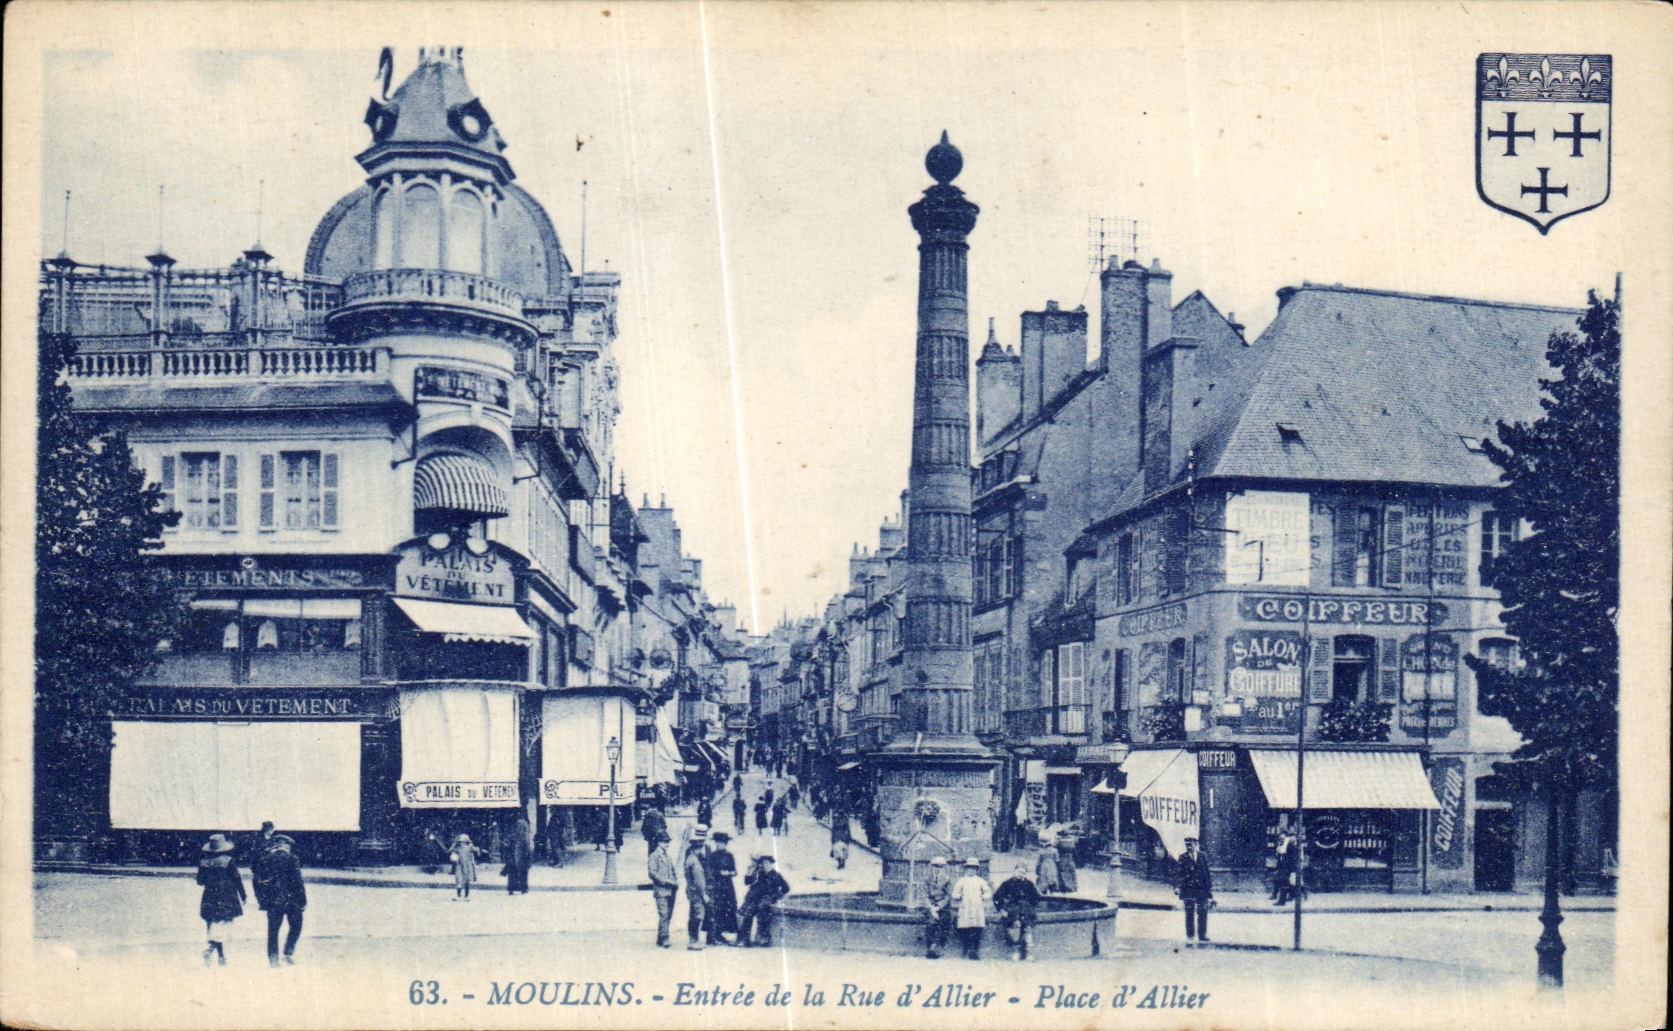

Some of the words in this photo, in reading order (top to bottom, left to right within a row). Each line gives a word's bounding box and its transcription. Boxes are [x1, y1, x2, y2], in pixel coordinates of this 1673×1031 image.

[420, 547, 495, 574] PALAIS
[447, 570, 467, 581] DU
[1256, 599, 1429, 623] COIFFEUR
[1232, 636, 1301, 662] SALON
[1229, 667, 1302, 699] COIFFURE
[212, 700, 231, 714] DU
[1258, 706, 1275, 718] au
[1199, 750, 1236, 768] COIFFEUR
[426, 783, 461, 799] PALAIS
[1141, 796, 1197, 826] COIFFEUR
[1433, 764, 1465, 852] COIFFEUR
